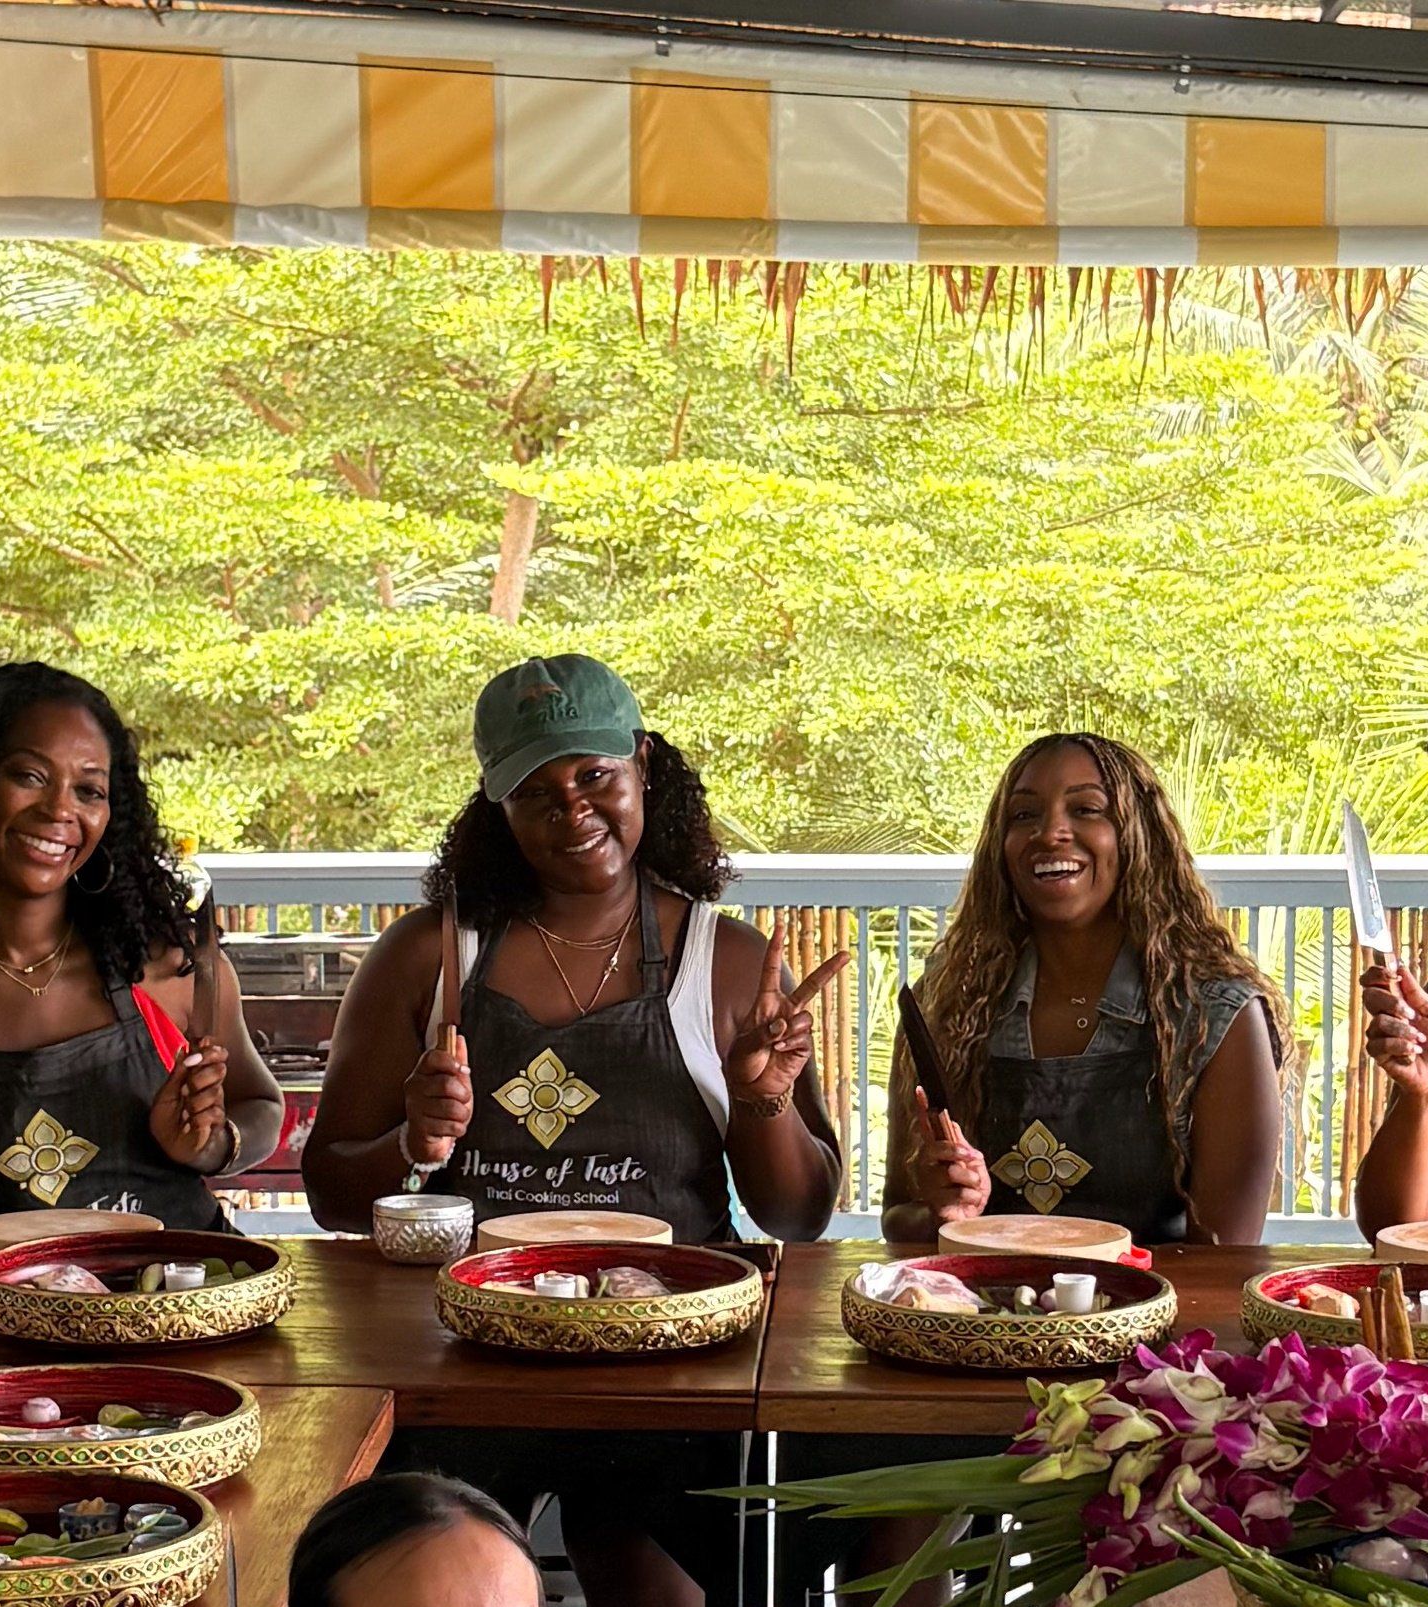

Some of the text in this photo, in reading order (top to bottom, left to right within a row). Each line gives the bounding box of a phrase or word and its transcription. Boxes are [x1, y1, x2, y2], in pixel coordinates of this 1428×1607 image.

[460, 1149, 648, 1188] House of Taste
[486, 1186, 620, 1207] Thai Cooking School
